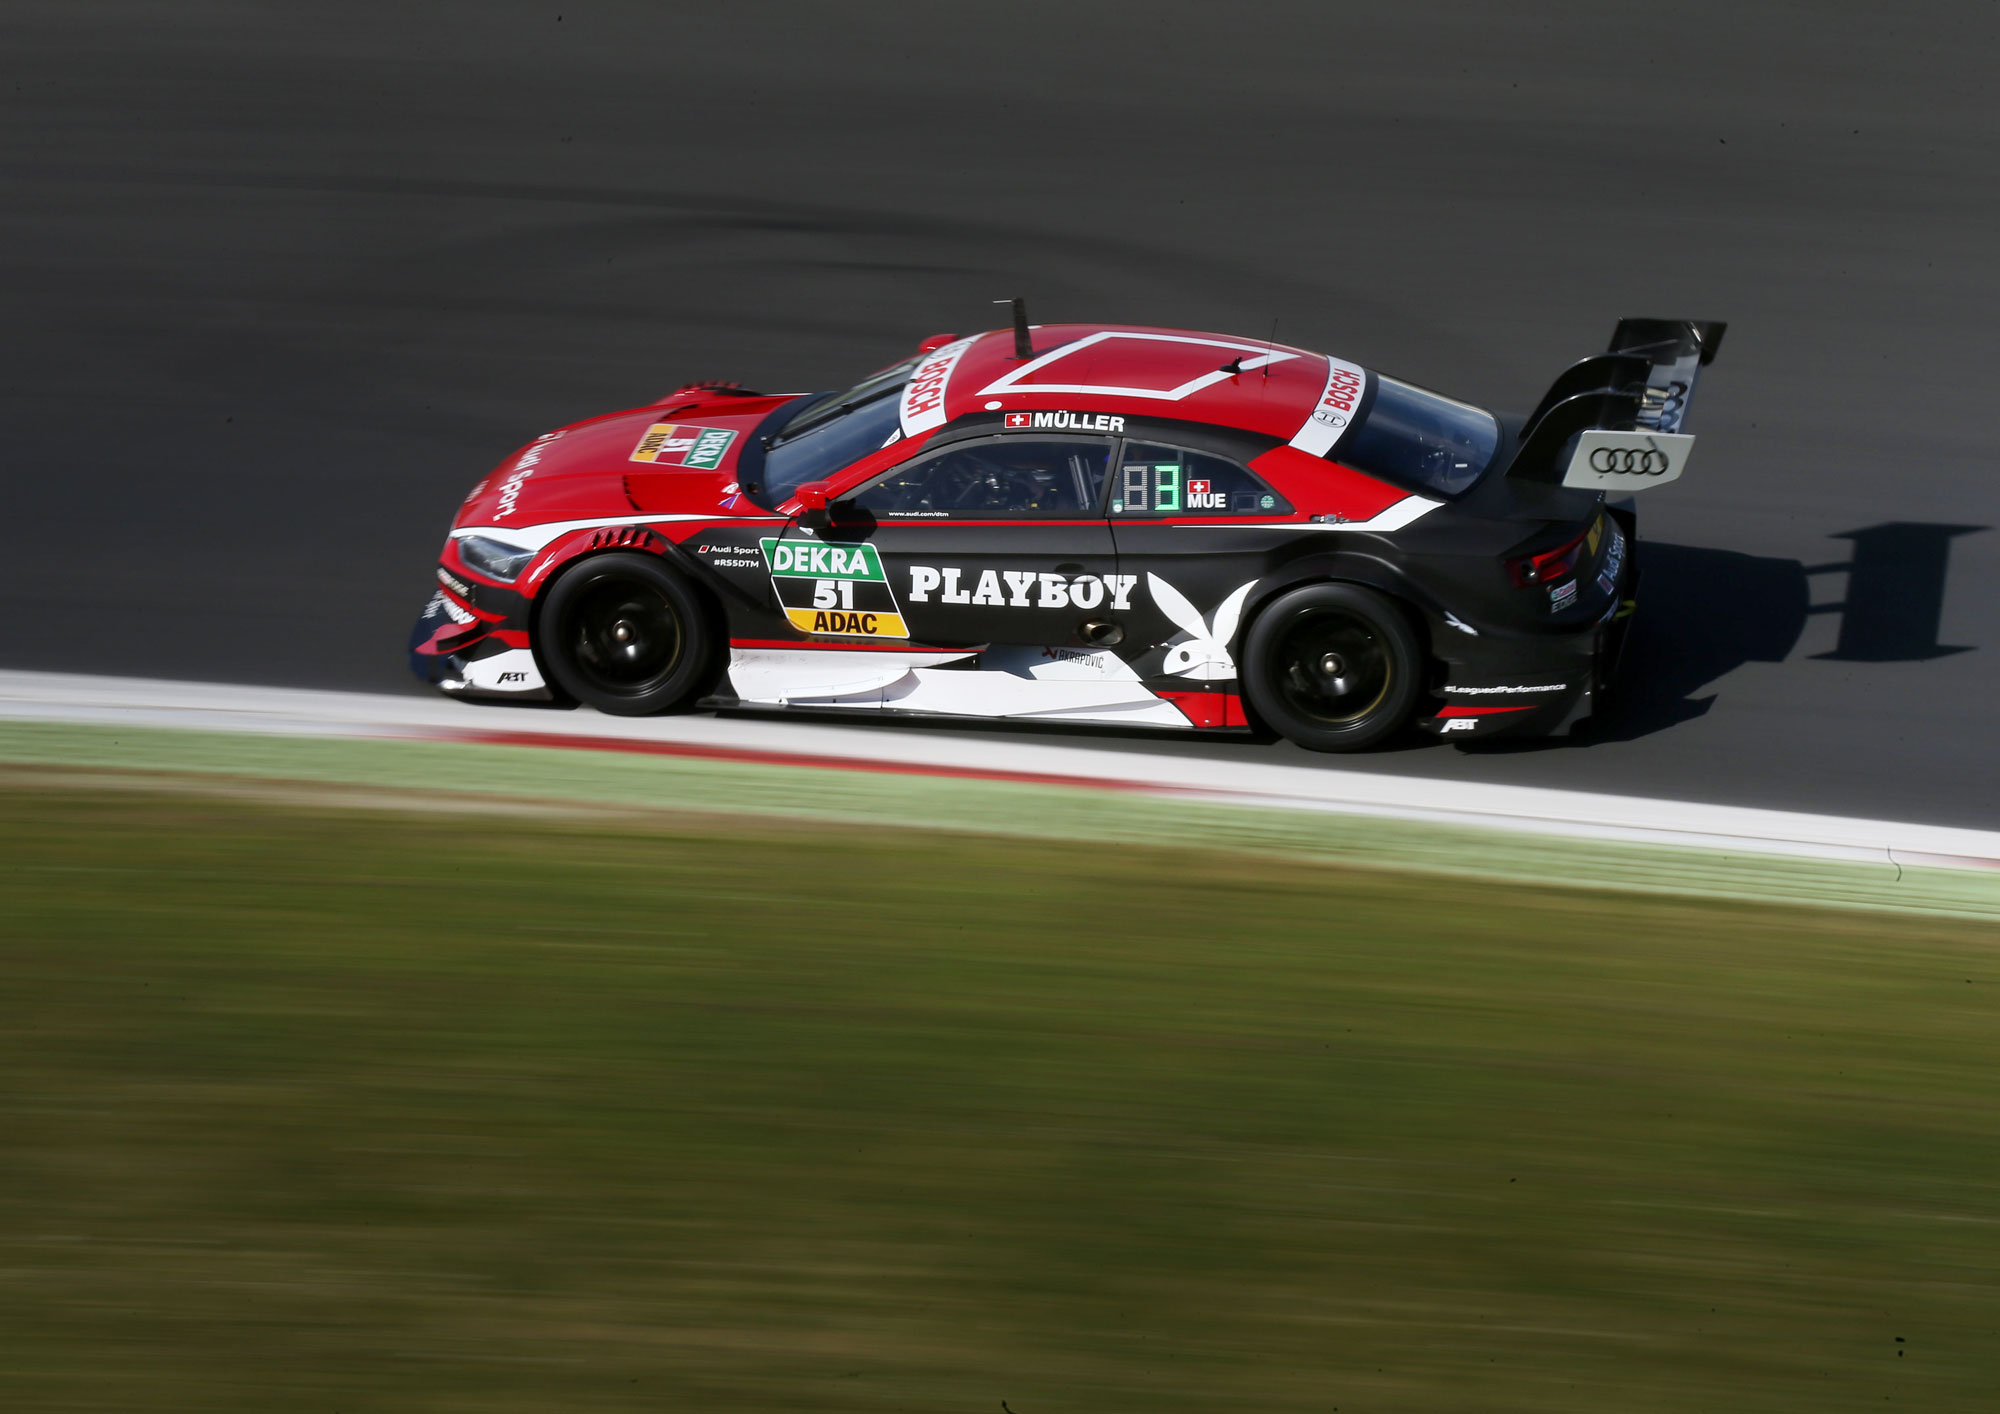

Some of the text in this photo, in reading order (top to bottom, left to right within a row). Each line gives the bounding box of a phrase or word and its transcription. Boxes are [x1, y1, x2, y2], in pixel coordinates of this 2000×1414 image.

[907, 357, 955, 419] BOSCH
[1323, 367, 1361, 412] BOSCH
[1034, 409, 1125, 433] MÜLLER
[637, 432, 668, 454] ADAC
[660, 438, 697, 453] 51
[687, 431, 732, 465] DEKRA
[492, 469, 534, 522] Sport
[1187, 493, 1227, 509] MUE
[710, 545, 760, 556] Audi Sport
[773, 545, 870, 576] DEKRA
[713, 558, 760, 568] #RS5DTM
[812, 579, 854, 610] 51
[909, 565, 1137, 610] PLAYBOY
[813, 611, 878, 635] ADAC
[496, 671, 529, 684] ABT
[1440, 718, 1479, 733] ABT
